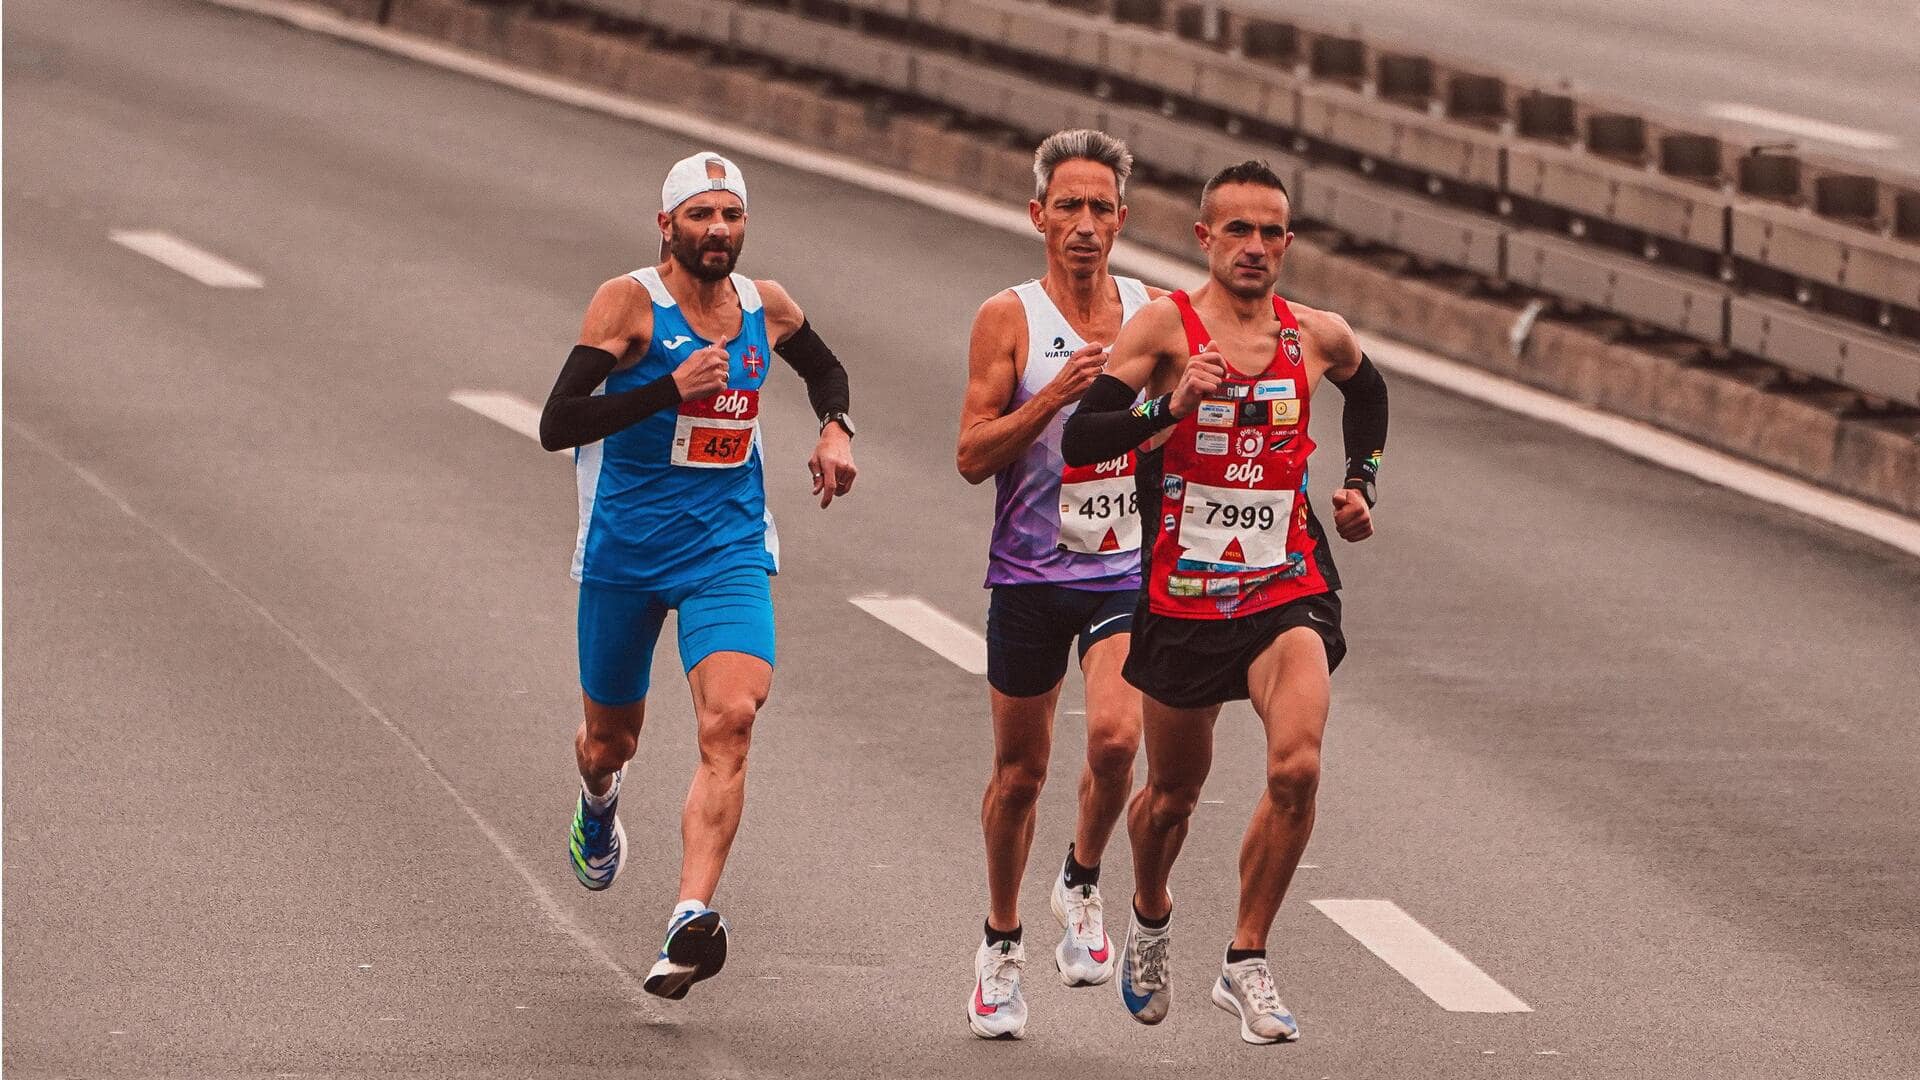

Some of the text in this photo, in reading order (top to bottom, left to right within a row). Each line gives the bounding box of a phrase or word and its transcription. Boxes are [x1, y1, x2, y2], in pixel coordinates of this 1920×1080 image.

[713, 390, 749, 419] edp
[704, 436, 742, 459] 457
[1224, 458, 1264, 489] edp
[1079, 491, 1138, 520] 4318
[1205, 501, 1275, 531] 7999
[1224, 550, 1242, 559] DELTA
